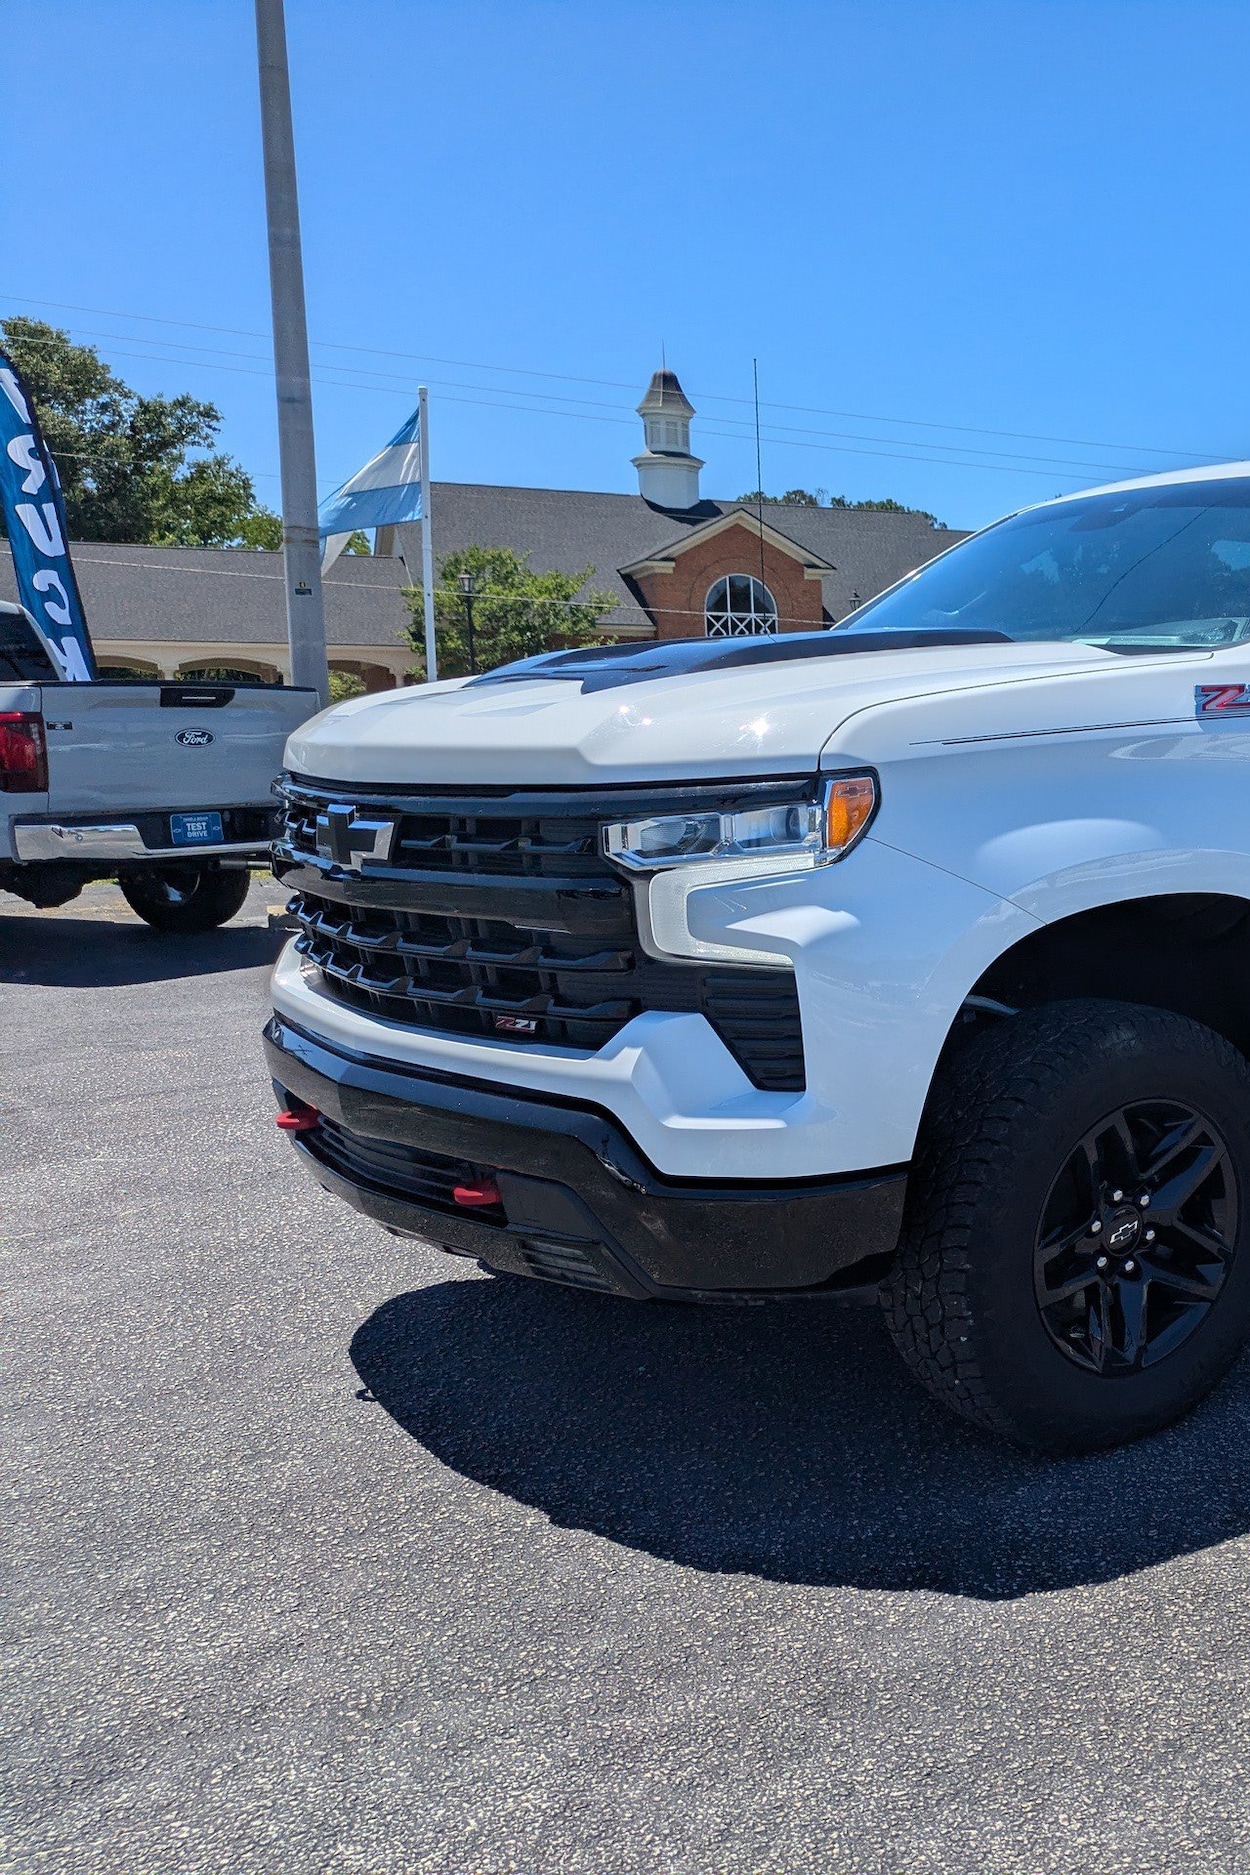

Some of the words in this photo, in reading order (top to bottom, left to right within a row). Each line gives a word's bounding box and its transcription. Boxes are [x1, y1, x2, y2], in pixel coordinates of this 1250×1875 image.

[186, 822, 207, 831] TEST
[187, 830, 208, 838] DRIVE
[495, 1015, 537, 1034] Z71
